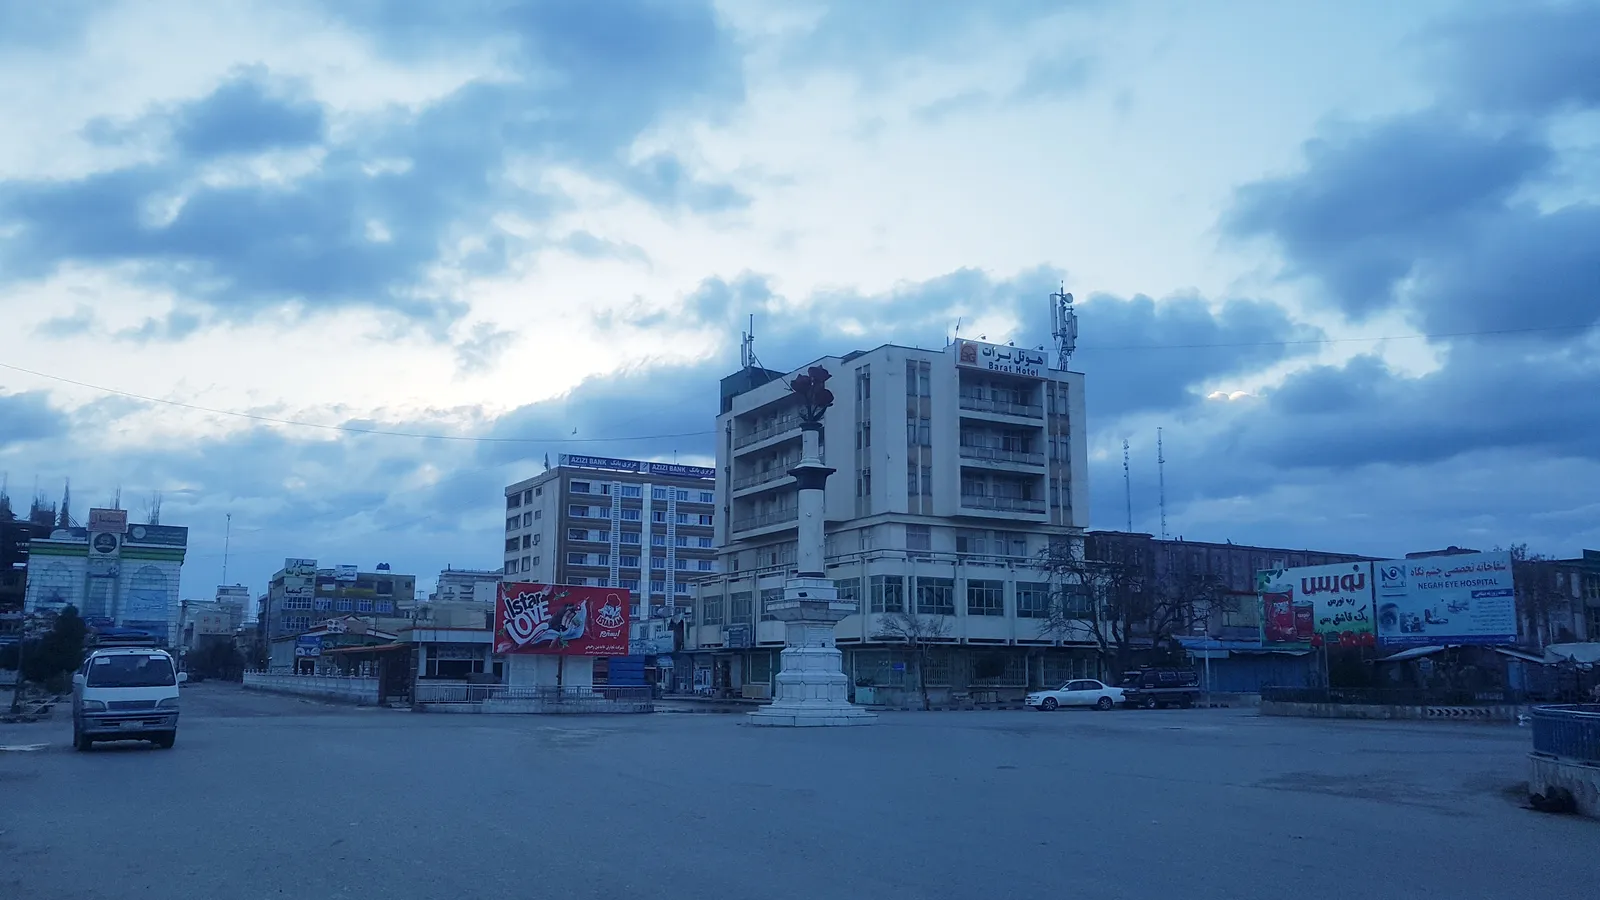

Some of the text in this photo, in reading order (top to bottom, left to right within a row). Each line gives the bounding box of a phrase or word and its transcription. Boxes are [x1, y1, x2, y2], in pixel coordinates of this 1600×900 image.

[982, 346, 1011, 362] برات
[1014, 351, 1043, 366] هوتل
[989, 362, 1038, 376] Barat Hotel
[1411, 560, 1506, 578] شفاخانه تخصصی چشم نگاه
[1418, 582, 1443, 590] NEGAH
[1460, 579, 1499, 587] HOSPITAL
[503, 601, 552, 644] LOVE
[1333, 611, 1352, 625] قاشق
